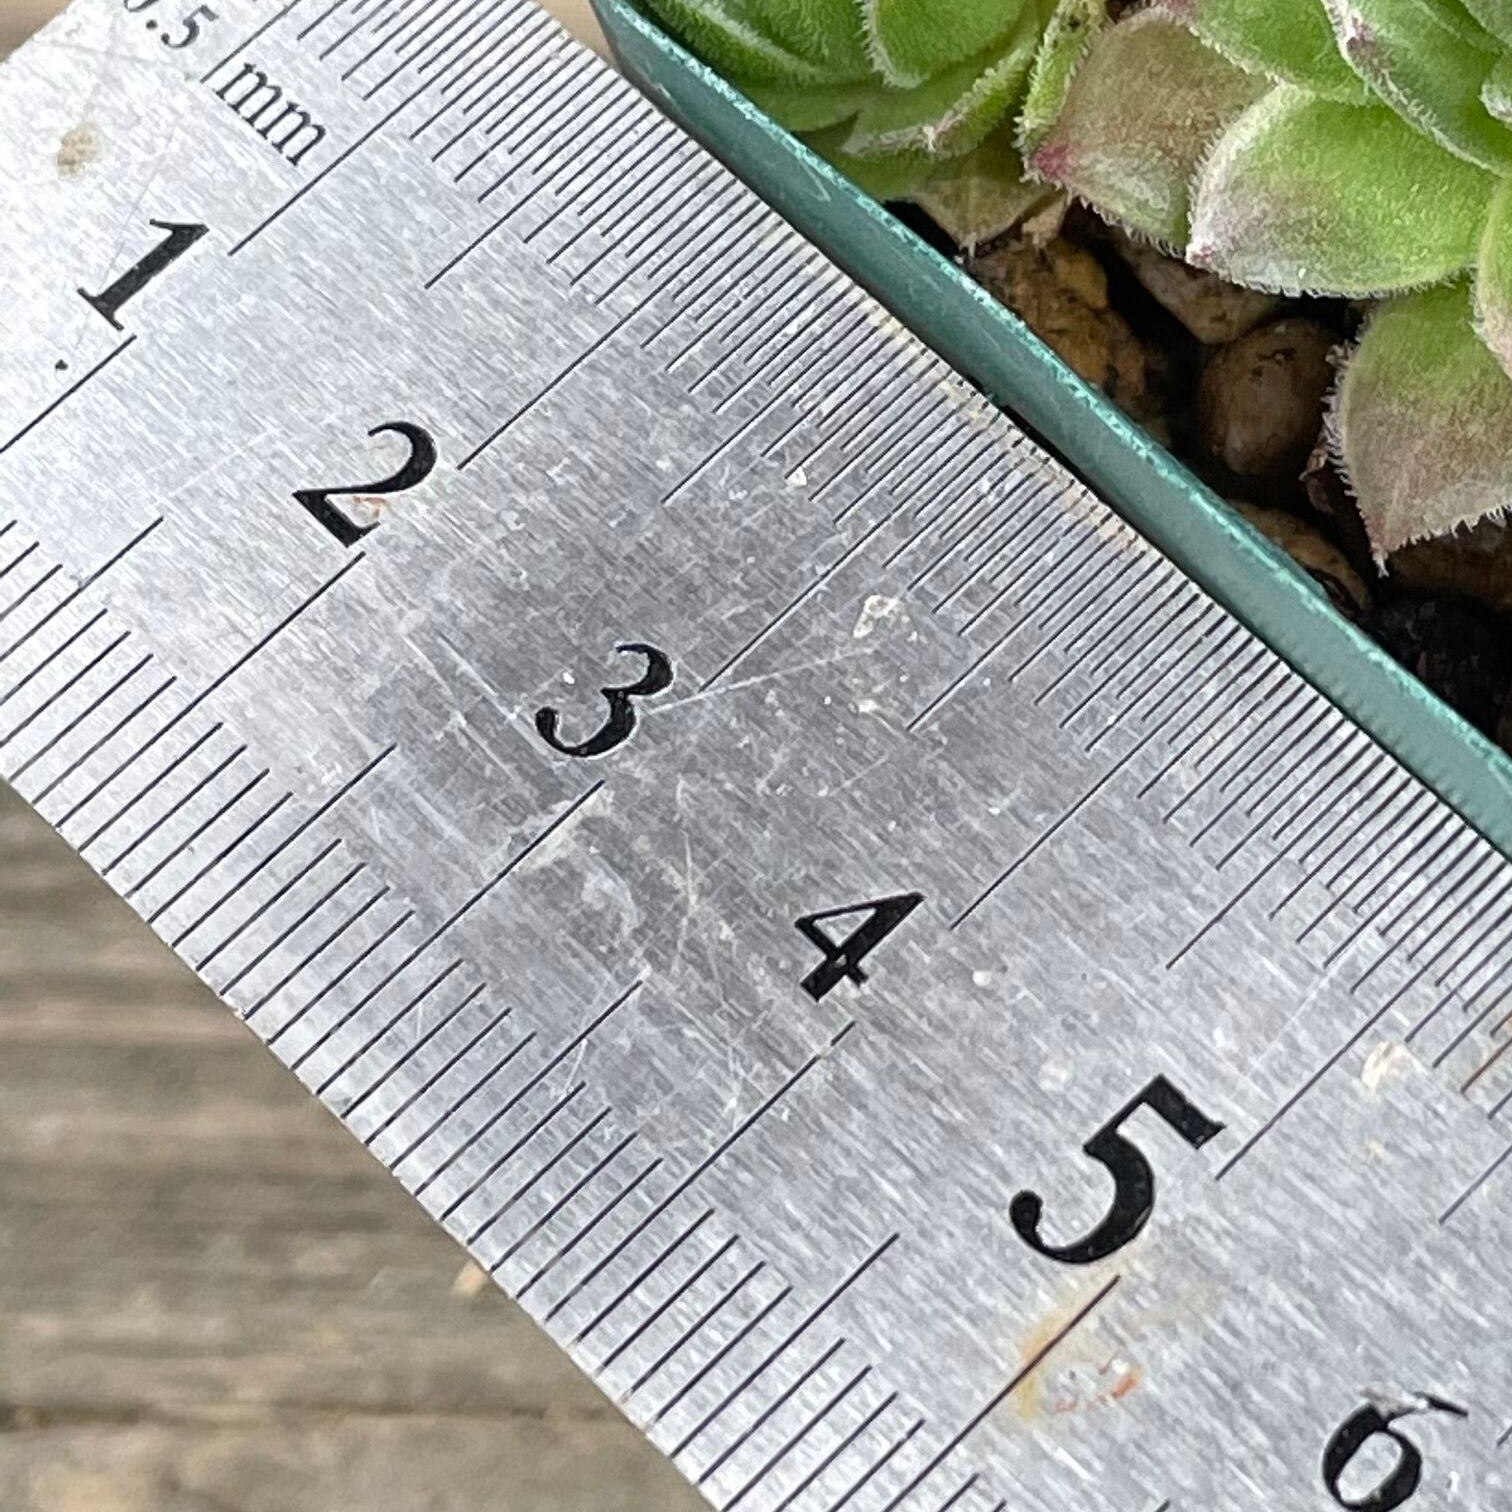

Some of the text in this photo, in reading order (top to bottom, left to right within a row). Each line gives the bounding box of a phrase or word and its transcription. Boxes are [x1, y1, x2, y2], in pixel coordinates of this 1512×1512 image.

[214, 60, 328, 167] mm
[77, 219, 208, 330] 1
[292, 422, 438, 548] 2
[535, 644, 673, 758] 3
[795, 892, 925, 1002] 4
[1009, 1074, 1226, 1264] 5
[1323, 1390, 1469, 1512] 6
